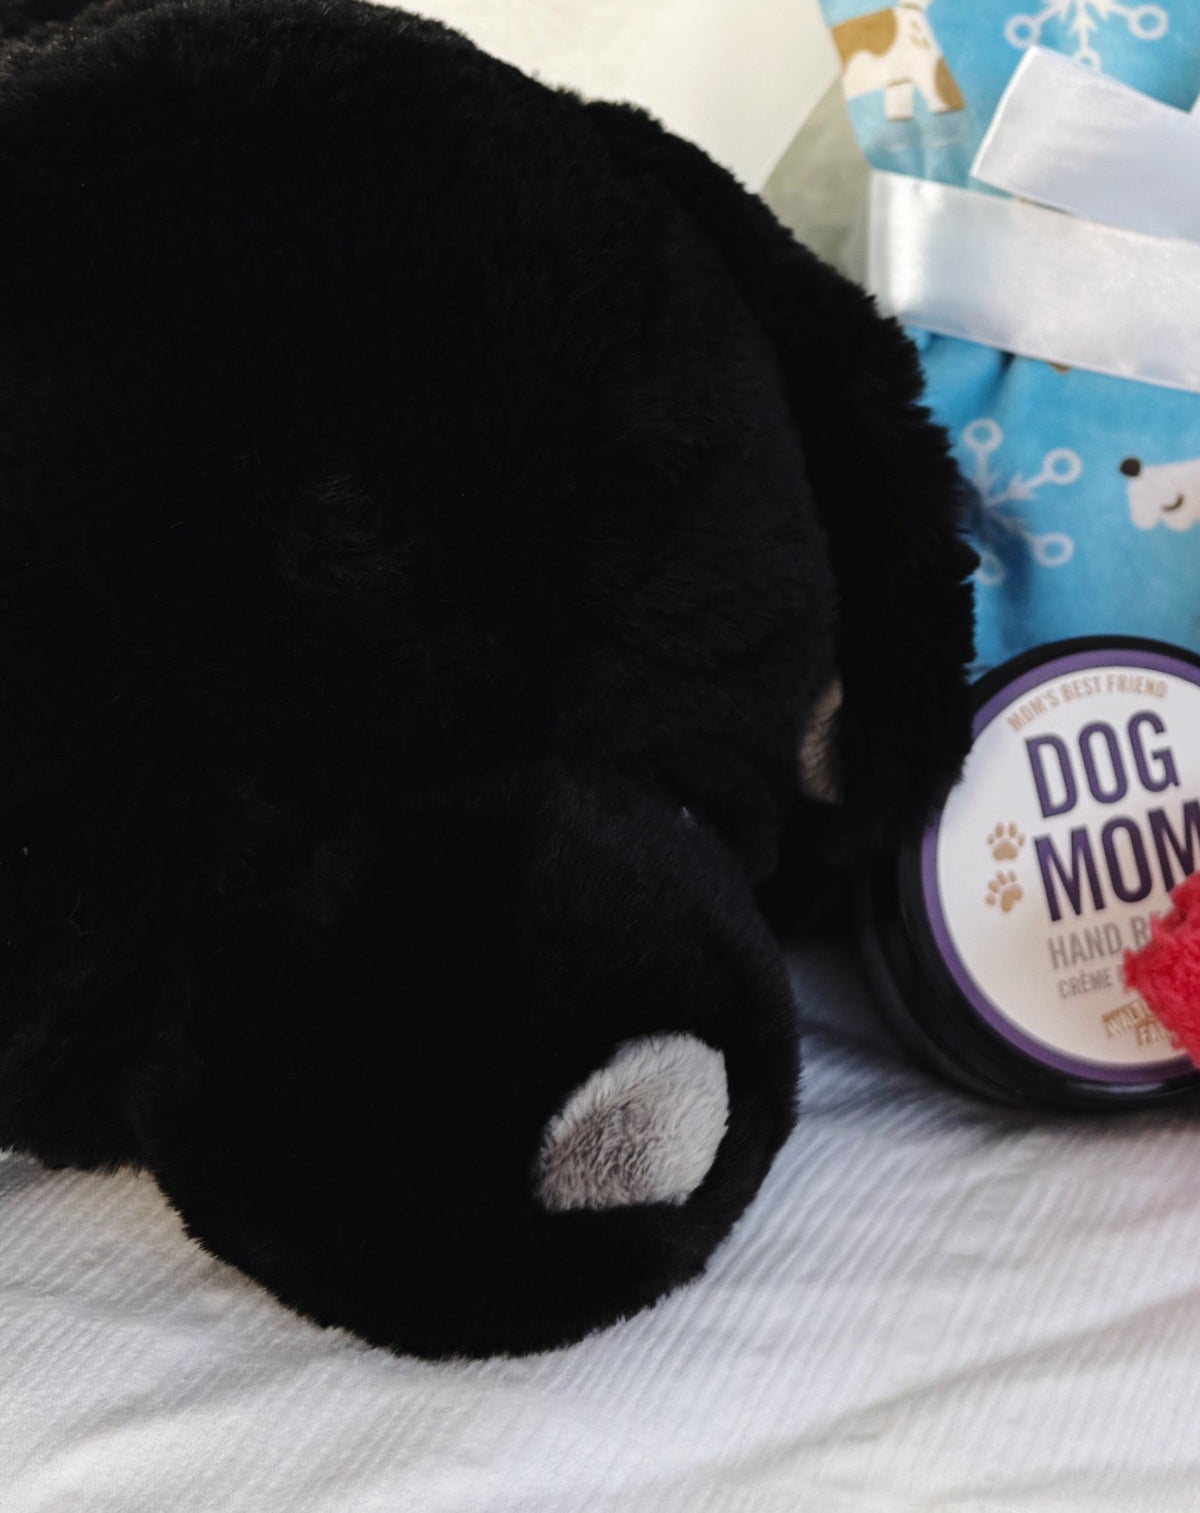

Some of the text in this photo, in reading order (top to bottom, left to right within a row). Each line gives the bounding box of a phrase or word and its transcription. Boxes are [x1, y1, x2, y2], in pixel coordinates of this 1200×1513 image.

[1007, 674, 1169, 732] MOM'S BEST FRIEND
[1025, 710, 1181, 818] DOG
[1048, 922, 1122, 970] HAND
